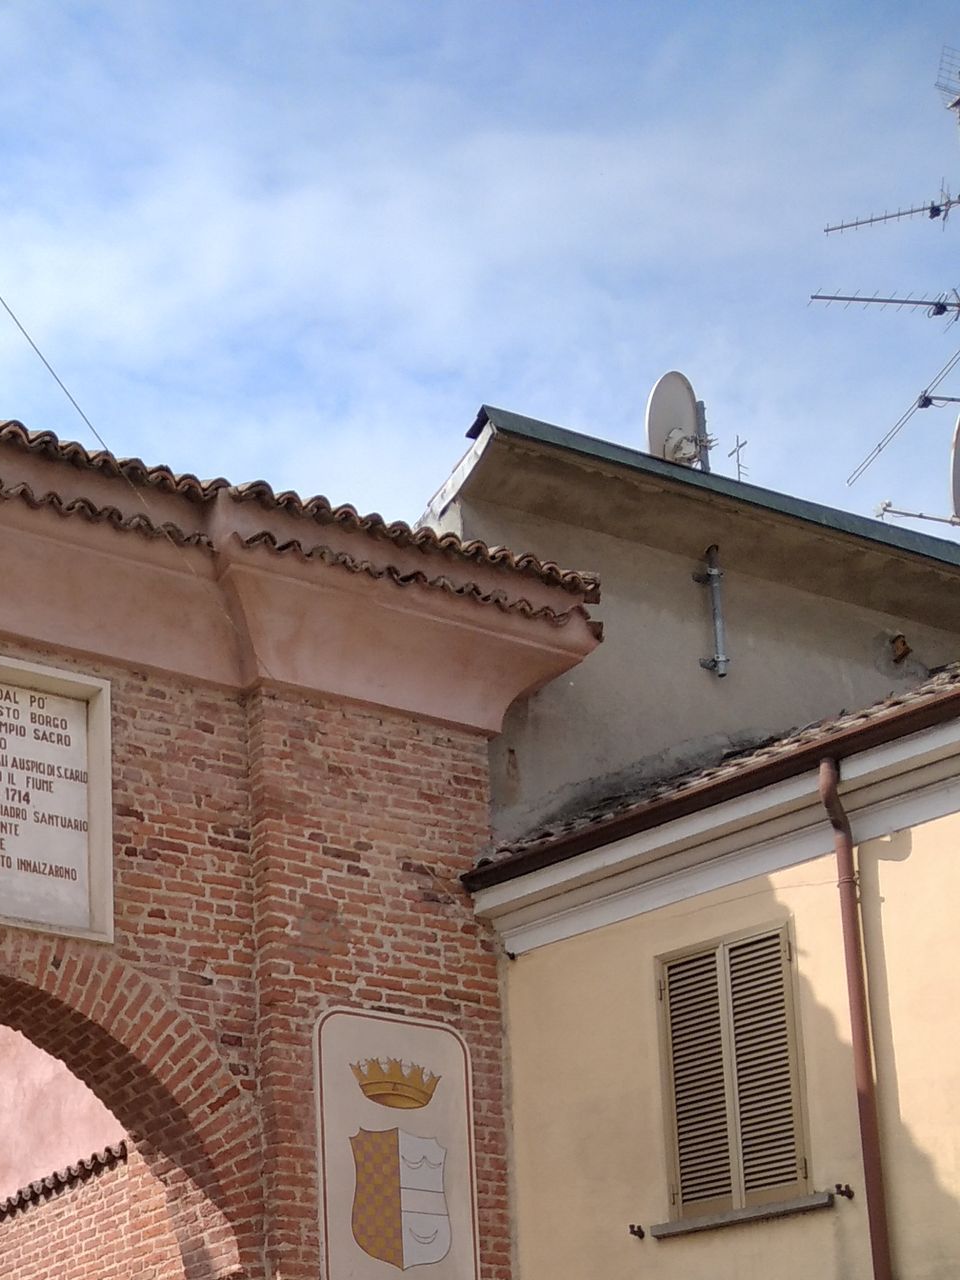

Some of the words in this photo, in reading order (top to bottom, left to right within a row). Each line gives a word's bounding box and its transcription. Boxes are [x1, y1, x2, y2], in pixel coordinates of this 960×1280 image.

[30, 712, 67, 730] BORGO
[8, 772, 16, 786] IL
[26, 776, 54, 793] FIUME
[5, 787, 31, 805] 1714
[33, 811, 88, 832] SANTUARIO
[17, 858, 77, 881] INNALZARONO
